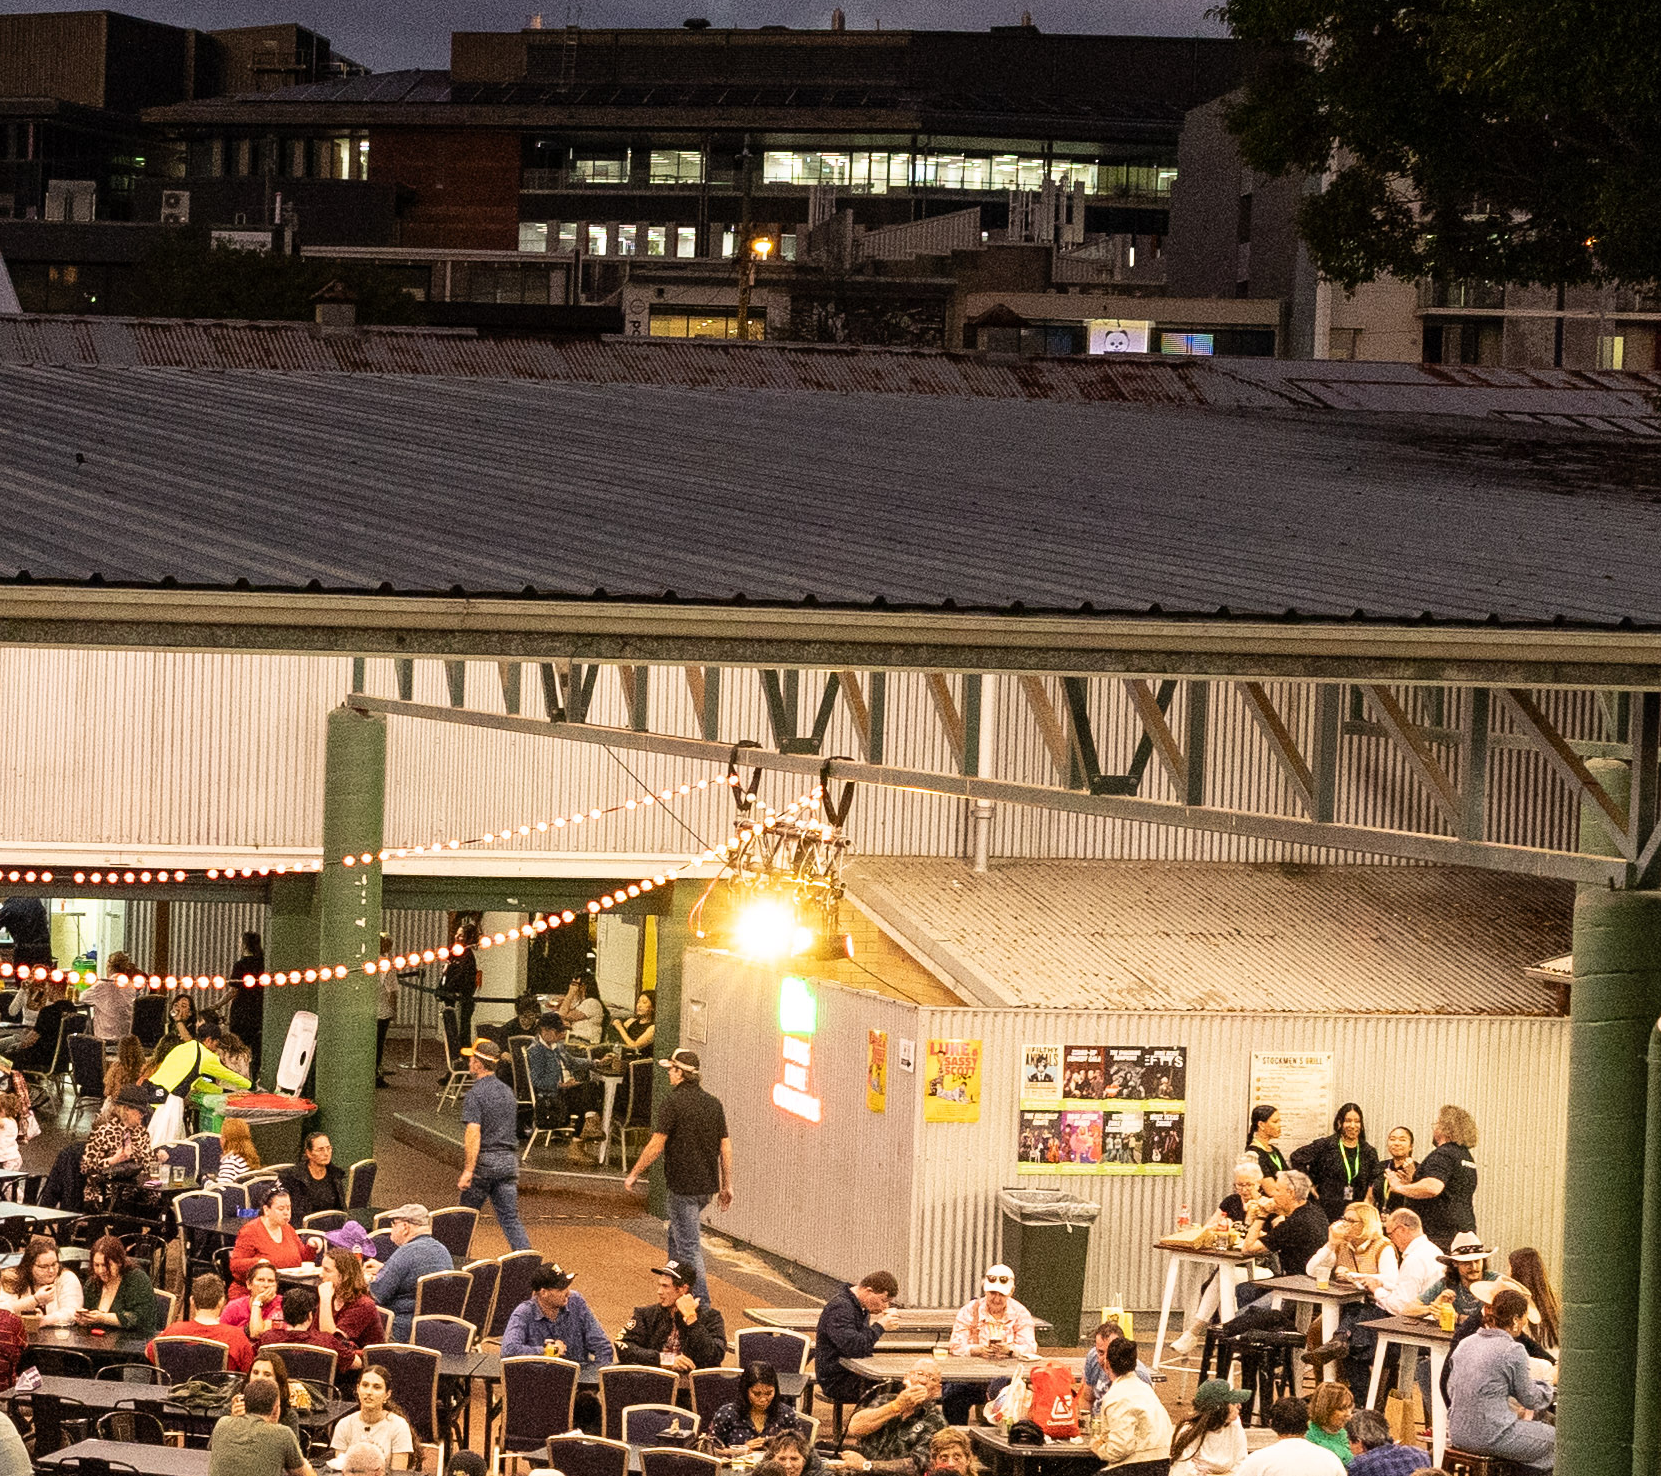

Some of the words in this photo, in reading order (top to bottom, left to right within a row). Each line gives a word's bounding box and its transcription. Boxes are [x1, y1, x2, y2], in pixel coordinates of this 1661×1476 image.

[930, 1042, 970, 1056] LUKE
[944, 1056, 978, 1066] SASSY
[944, 1066, 976, 1075] SCOTT
